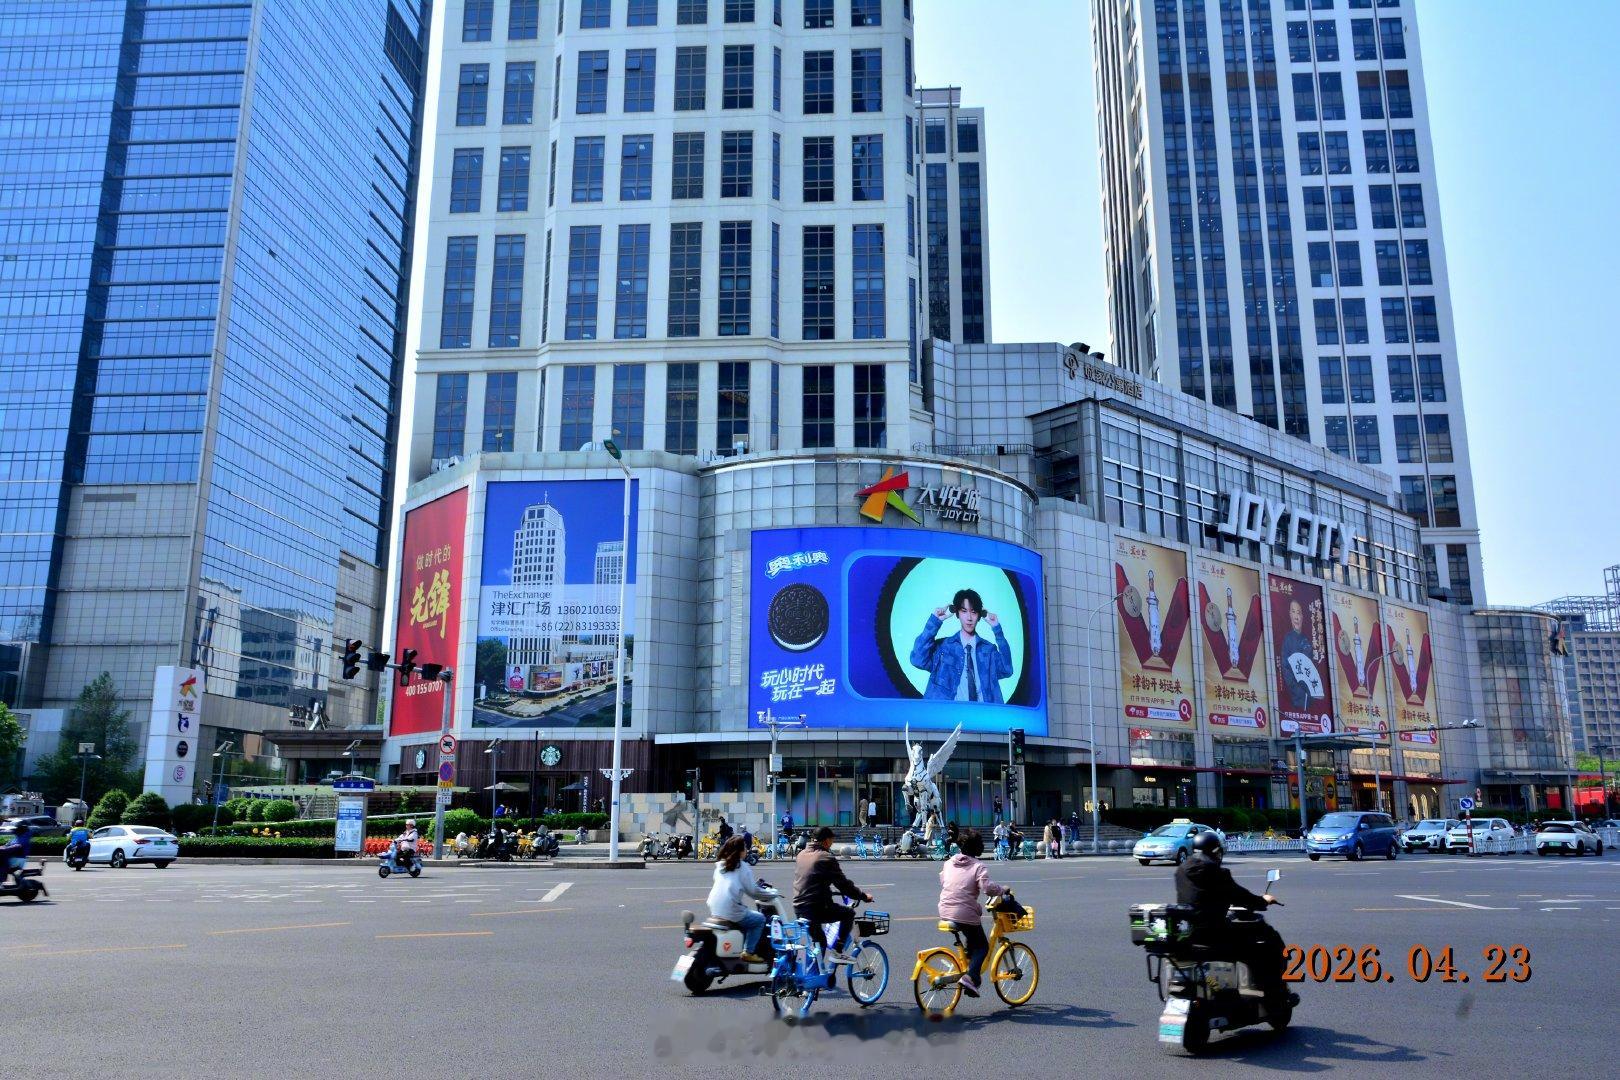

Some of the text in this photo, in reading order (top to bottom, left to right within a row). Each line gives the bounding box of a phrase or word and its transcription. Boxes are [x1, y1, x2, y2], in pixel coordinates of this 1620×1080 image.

[918, 482, 981, 510] 大悦城
[943, 508, 982, 522] JOY CITY
[766, 550, 830, 578] 奥利奥
[492, 590, 551, 600] TheExchange
[491, 601, 551, 616] 津汇广场
[760, 664, 825, 688] 玩心时代
[428, 680, 443, 692] 0707
[771, 678, 836, 702] 玩在一起
